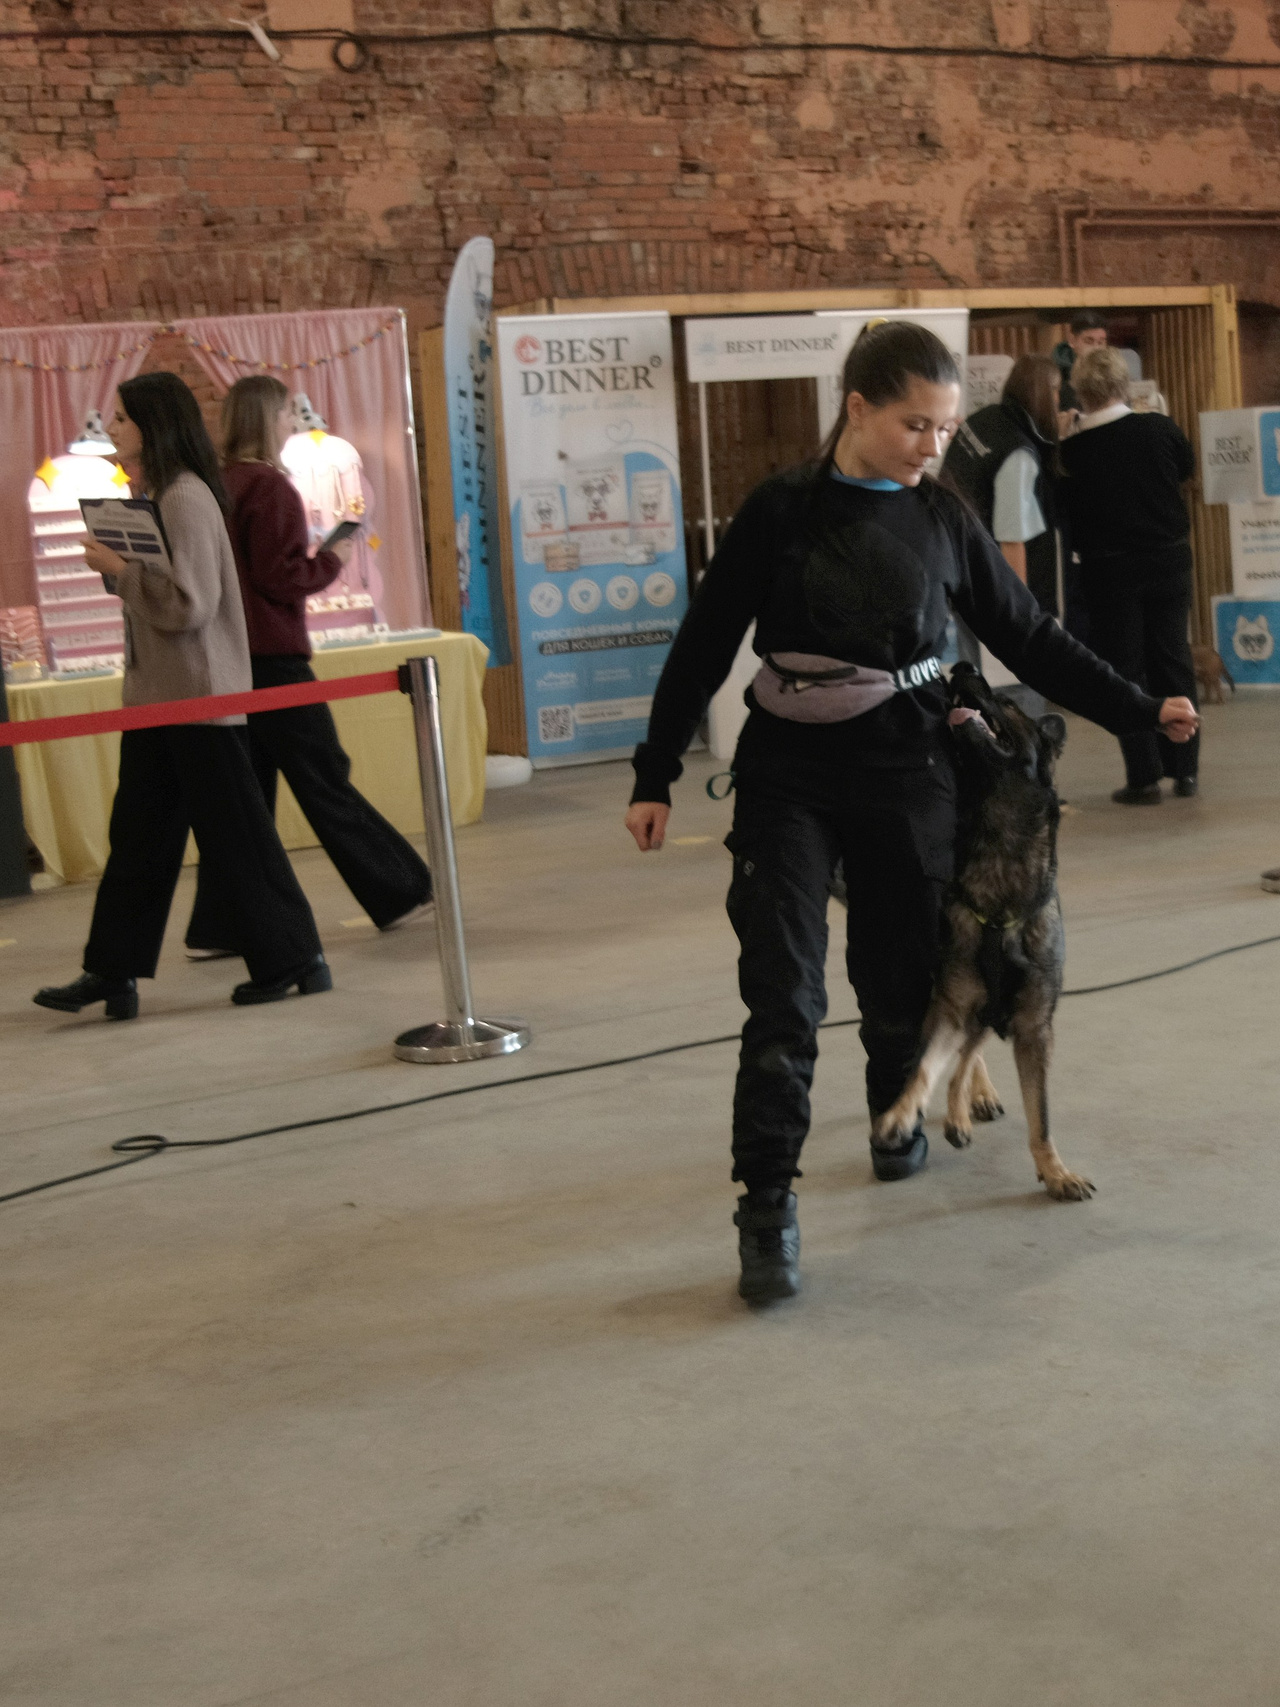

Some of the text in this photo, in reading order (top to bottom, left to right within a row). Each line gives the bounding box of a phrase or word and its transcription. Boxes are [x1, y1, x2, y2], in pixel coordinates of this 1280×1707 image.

[545, 337, 629, 365] BEST
[725, 340, 766, 354] BEST
[543, 632, 672, 655] ДЛЯ КОШЕК И СОБАК
